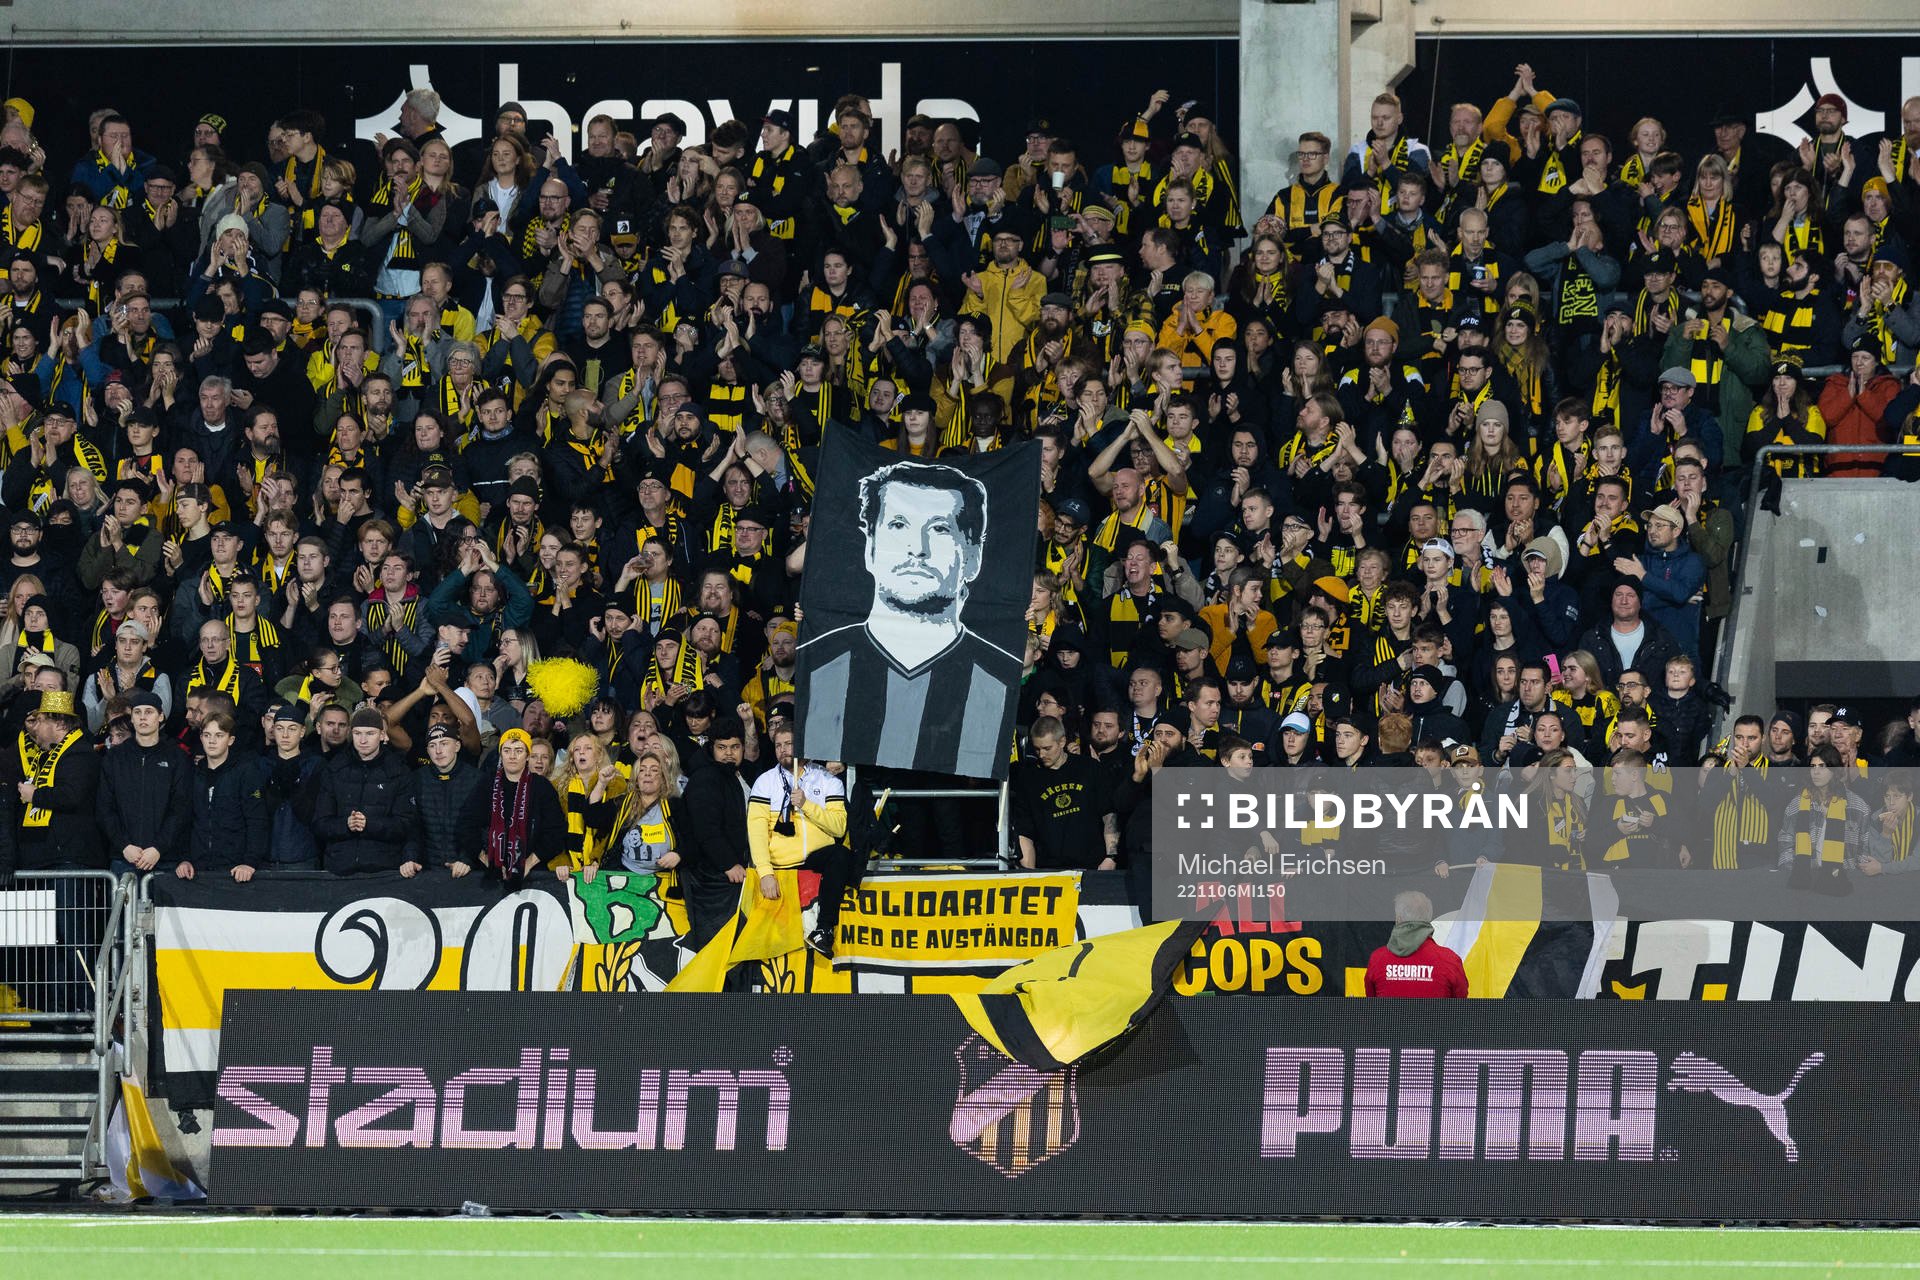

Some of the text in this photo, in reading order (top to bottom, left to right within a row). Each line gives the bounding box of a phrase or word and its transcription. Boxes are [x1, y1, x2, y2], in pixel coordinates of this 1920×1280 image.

[840, 885, 1063, 917] SOLIDARITET
[1195, 881, 1303, 937] ALL
[841, 923, 1059, 949] MED DE AVSTÄNGDA
[1173, 936, 1323, 997] COPS
[1385, 964, 1434, 978] SECURITY
[211, 1045, 792, 1150] stadium
[1261, 1046, 1658, 1161] PUMA
